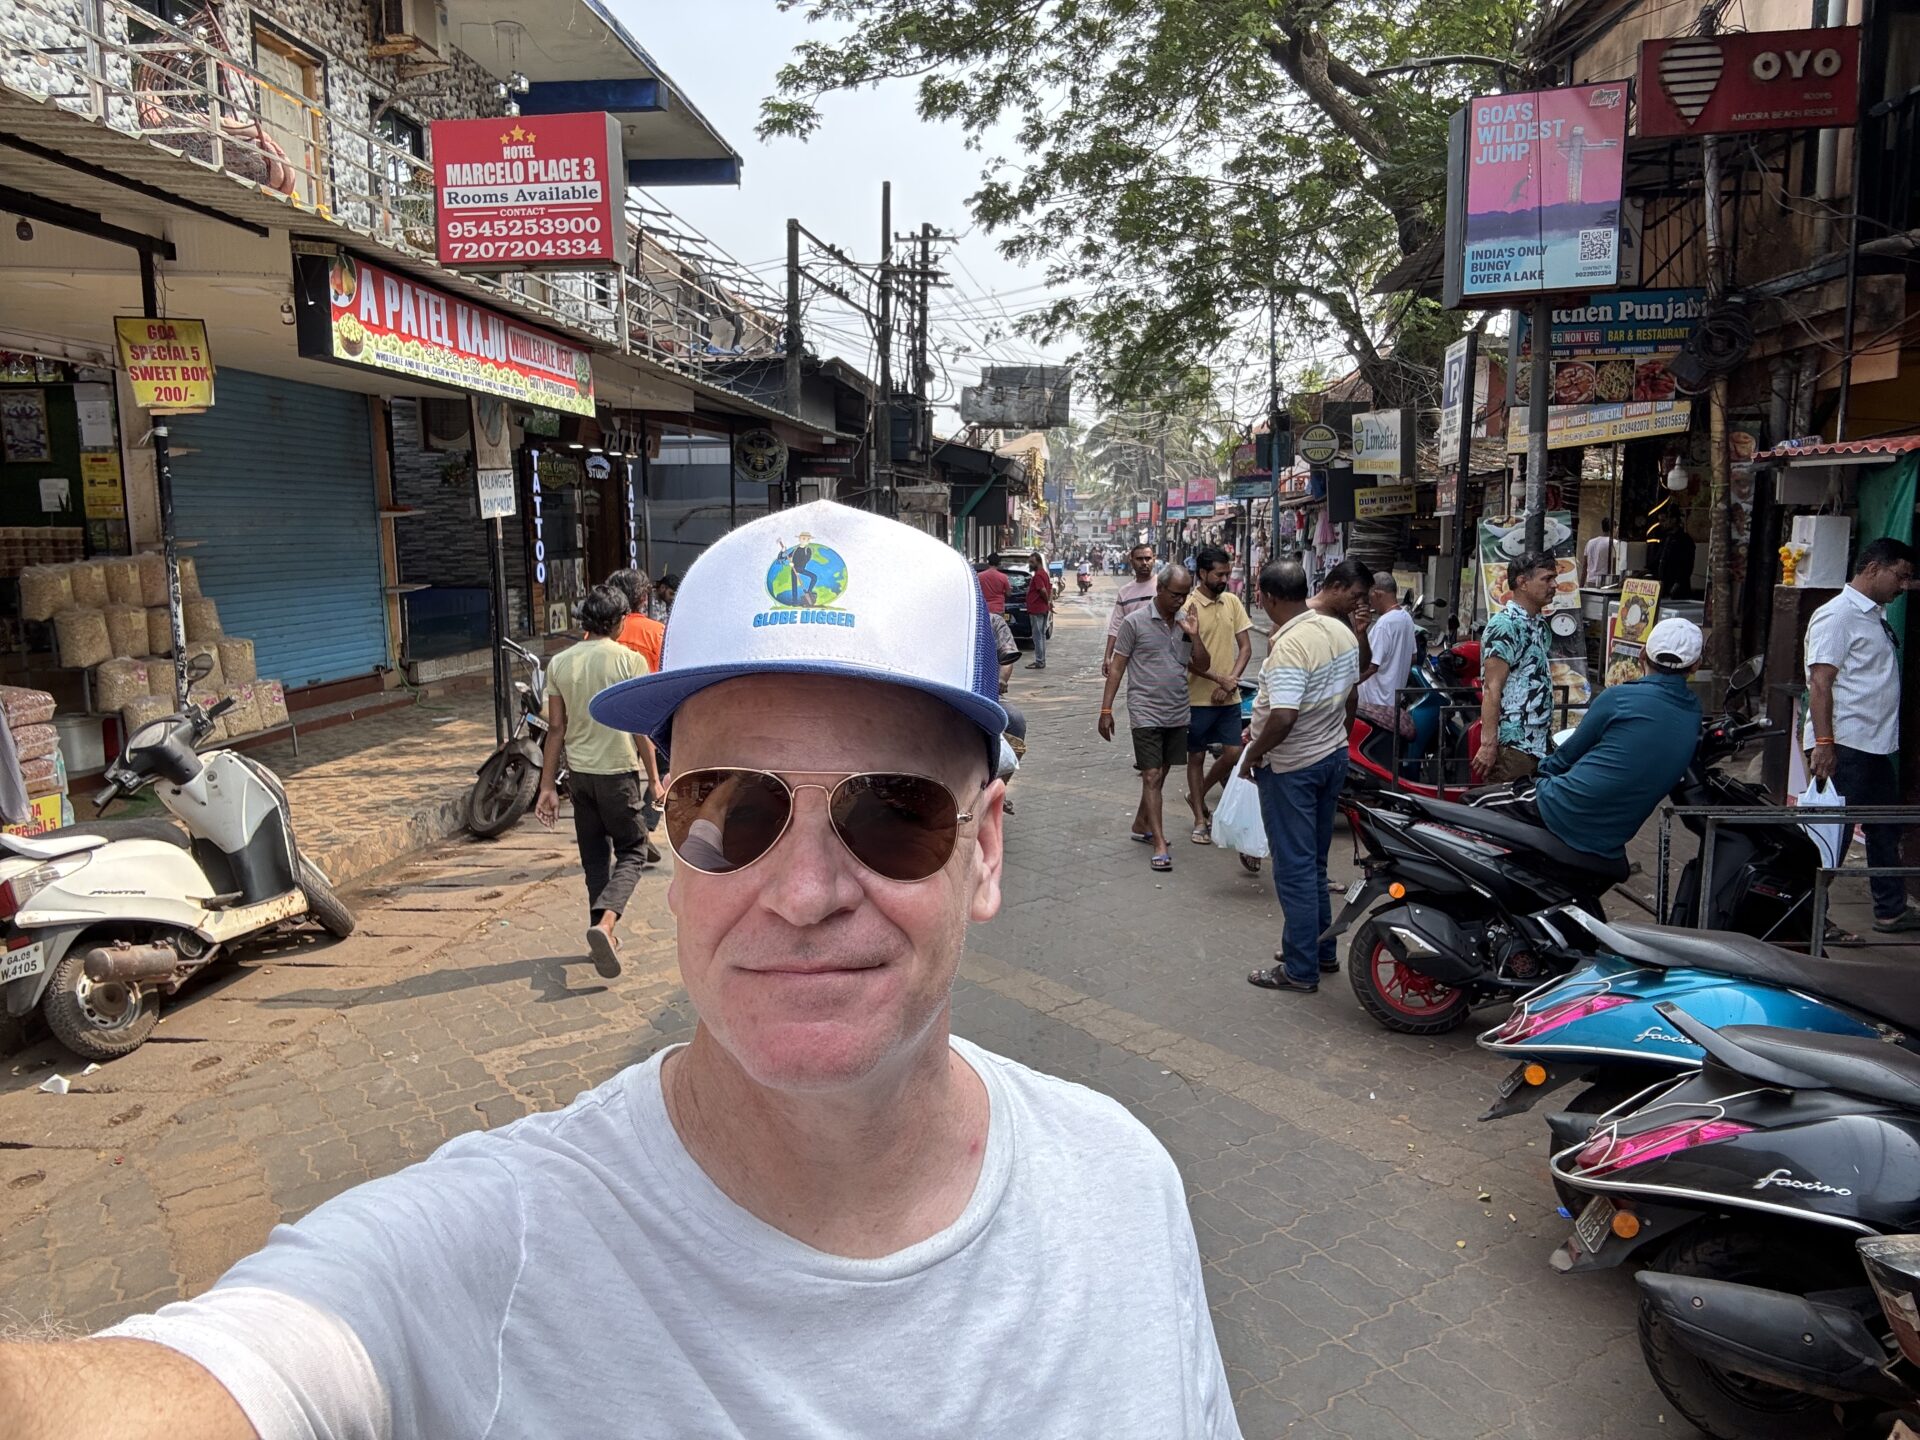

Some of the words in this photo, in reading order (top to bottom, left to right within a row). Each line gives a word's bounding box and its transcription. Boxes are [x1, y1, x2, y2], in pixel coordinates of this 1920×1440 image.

[1753, 48, 1841, 80] OYO
[1477, 102, 1533, 125] GOA'S
[1731, 111, 1770, 121] ANCORA
[1771, 110, 1801, 119] BEACH
[1804, 107, 1838, 117] RESORT
[1477, 119, 1565, 145] WILDEST
[503, 145, 535, 160] HOTEL
[1475, 142, 1530, 165] JUMP
[446, 161, 525, 186] MARCELO
[528, 158, 581, 183] PLACE
[583, 157, 595, 180] 3
[447, 190, 508, 205] Rooms
[514, 185, 598, 203] Available
[500, 207, 545, 217] CONTACT
[447, 216, 601, 238] 9545253900
[449, 238, 602, 259] 7207204334
[1471, 247, 1515, 260] INDIA'S
[1518, 245, 1548, 257] ONLY
[1471, 260, 1511, 273] BUNGY
[1470, 273, 1501, 285] OVER
[1504, 272, 1511, 283] A
[1514, 270, 1544, 282] LAKE
[360, 268, 379, 326] A
[383, 276, 453, 348] PATEL
[456, 304, 507, 363] KAJU
[1618, 296, 1708, 324] Punjabi
[147, 324, 177, 340] GOA
[1552, 332, 1562, 343] EG
[1565, 332, 1581, 343] NON
[1584, 331, 1600, 342] VEG
[1608, 330, 1625, 342] BAR
[1627, 330, 1633, 341] &
[1637, 327, 1690, 341] RESTAURANT
[129, 344, 189, 361] SPECIAL
[190, 346, 200, 361] 5
[510, 330, 555, 369] WHOLESALE
[1620, 345, 1654, 354] CONTINENTAL
[375, 351, 404, 366] WHOLESALE
[405, 360, 415, 369] AND
[129, 365, 177, 381] SWEET
[1450, 362, 1460, 402] P
[154, 386, 195, 402] 200/-
[544, 378, 565, 396] APPROVED
[1567, 415, 1586, 428] CHINESE
[1590, 407, 1622, 424] CONTINENTAL
[1365, 425, 1398, 451] Limelite
[1359, 497, 1377, 505] DUM
[531, 450, 546, 584] TATTOO
[1626, 580, 1639, 593] FISH
[1640, 582, 1657, 595] THALI
[753, 611, 798, 628] GLOBE
[800, 610, 856, 628] DIGGER
[1633, 1027, 1700, 1047] fascin
